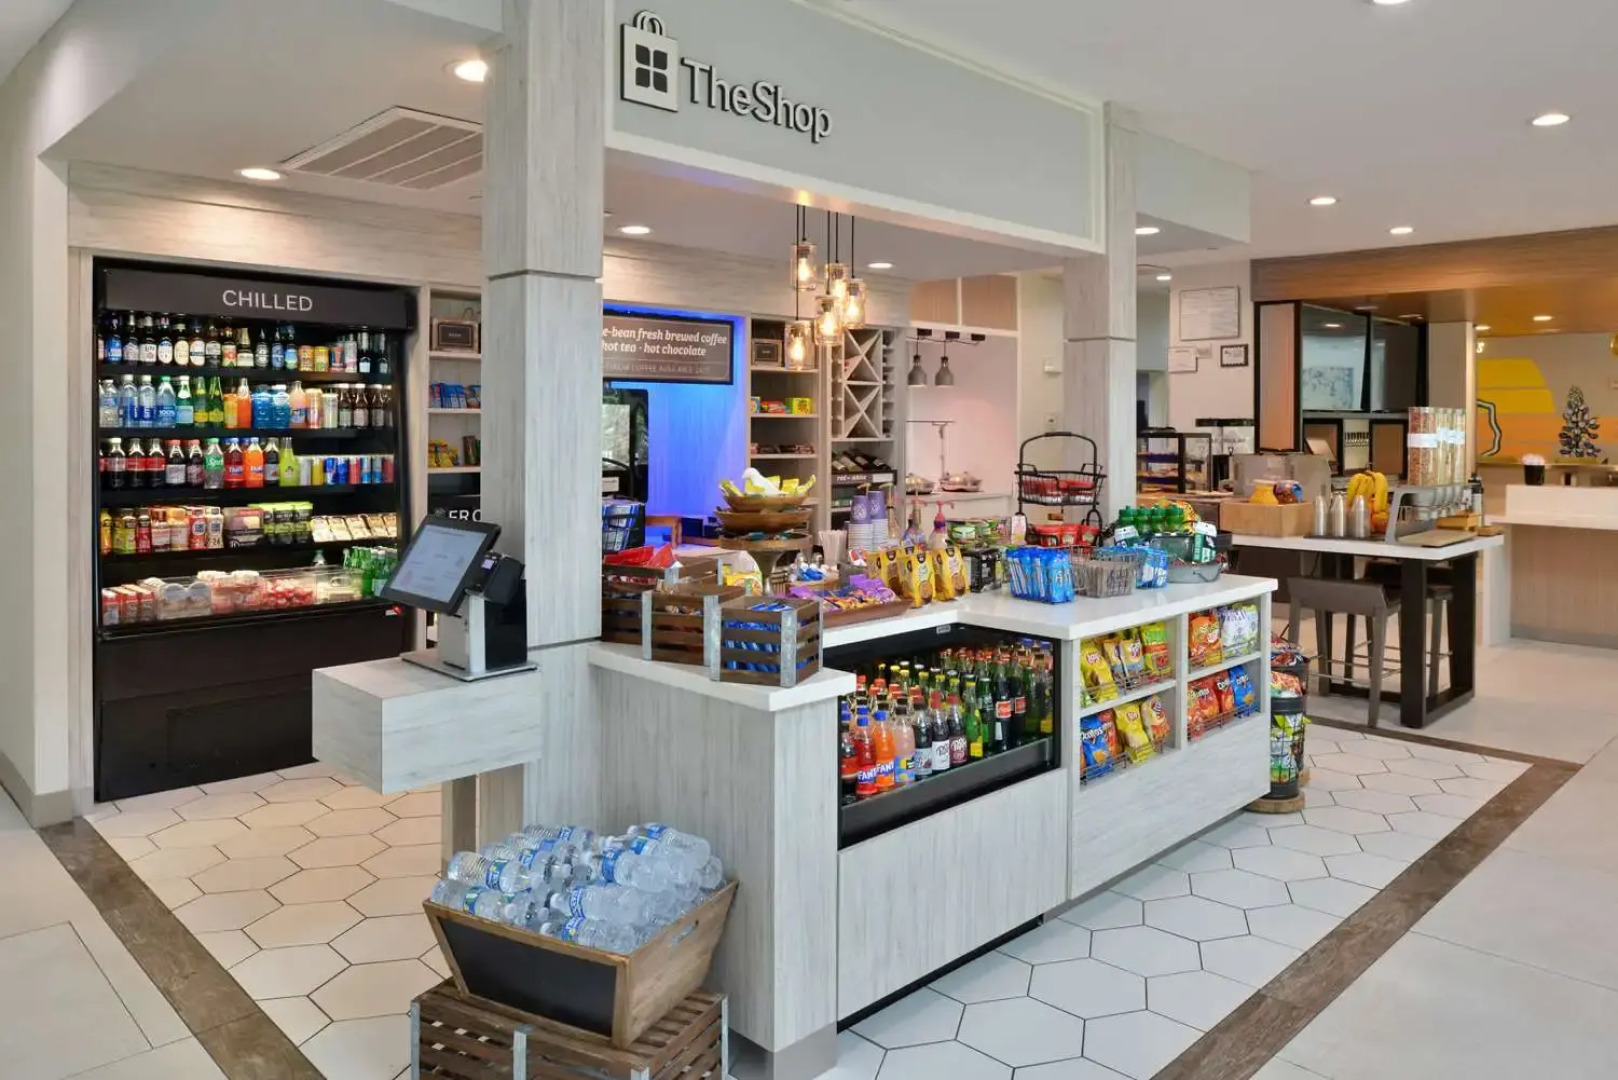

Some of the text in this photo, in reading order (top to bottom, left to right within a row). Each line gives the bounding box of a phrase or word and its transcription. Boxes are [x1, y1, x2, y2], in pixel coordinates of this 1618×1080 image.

[681, 57, 833, 144] TheShop
[222, 289, 313, 311] CHILLED
[637, 327, 663, 342] fresh
[664, 330, 700, 343] brewed
[700, 333, 728, 346] coffee
[620, 342, 637, 353] tea
[643, 343, 660, 354] hot
[661, 344, 707, 356] chocolate
